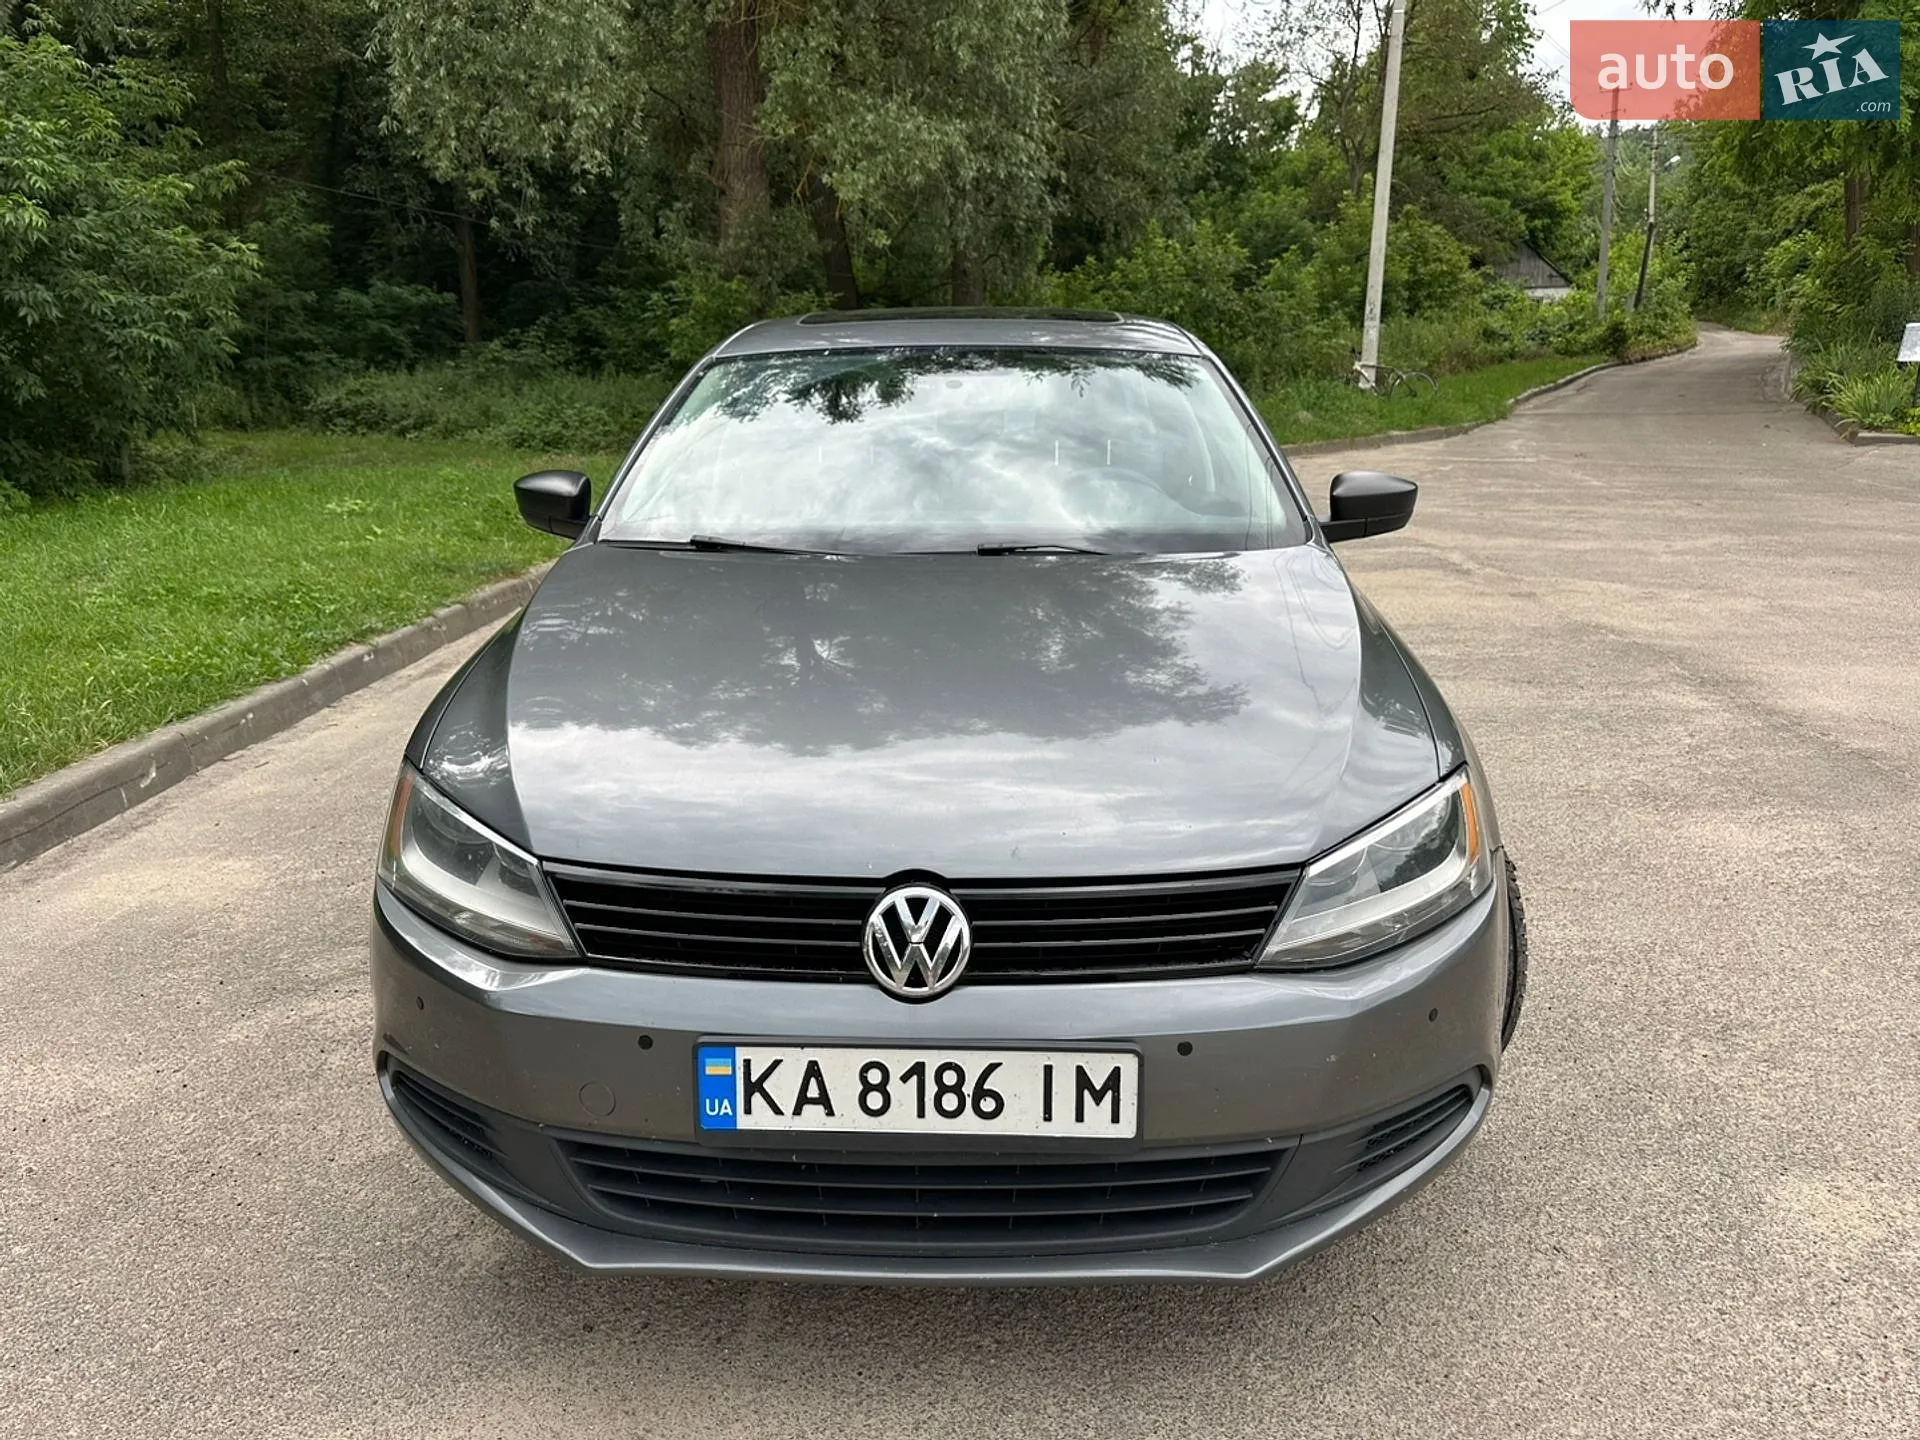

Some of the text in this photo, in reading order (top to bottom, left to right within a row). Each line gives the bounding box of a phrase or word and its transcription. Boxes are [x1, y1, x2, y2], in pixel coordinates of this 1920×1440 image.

[705, 1098, 733, 1116] UA
[742, 1058, 1121, 1124] KA 8186 IM
